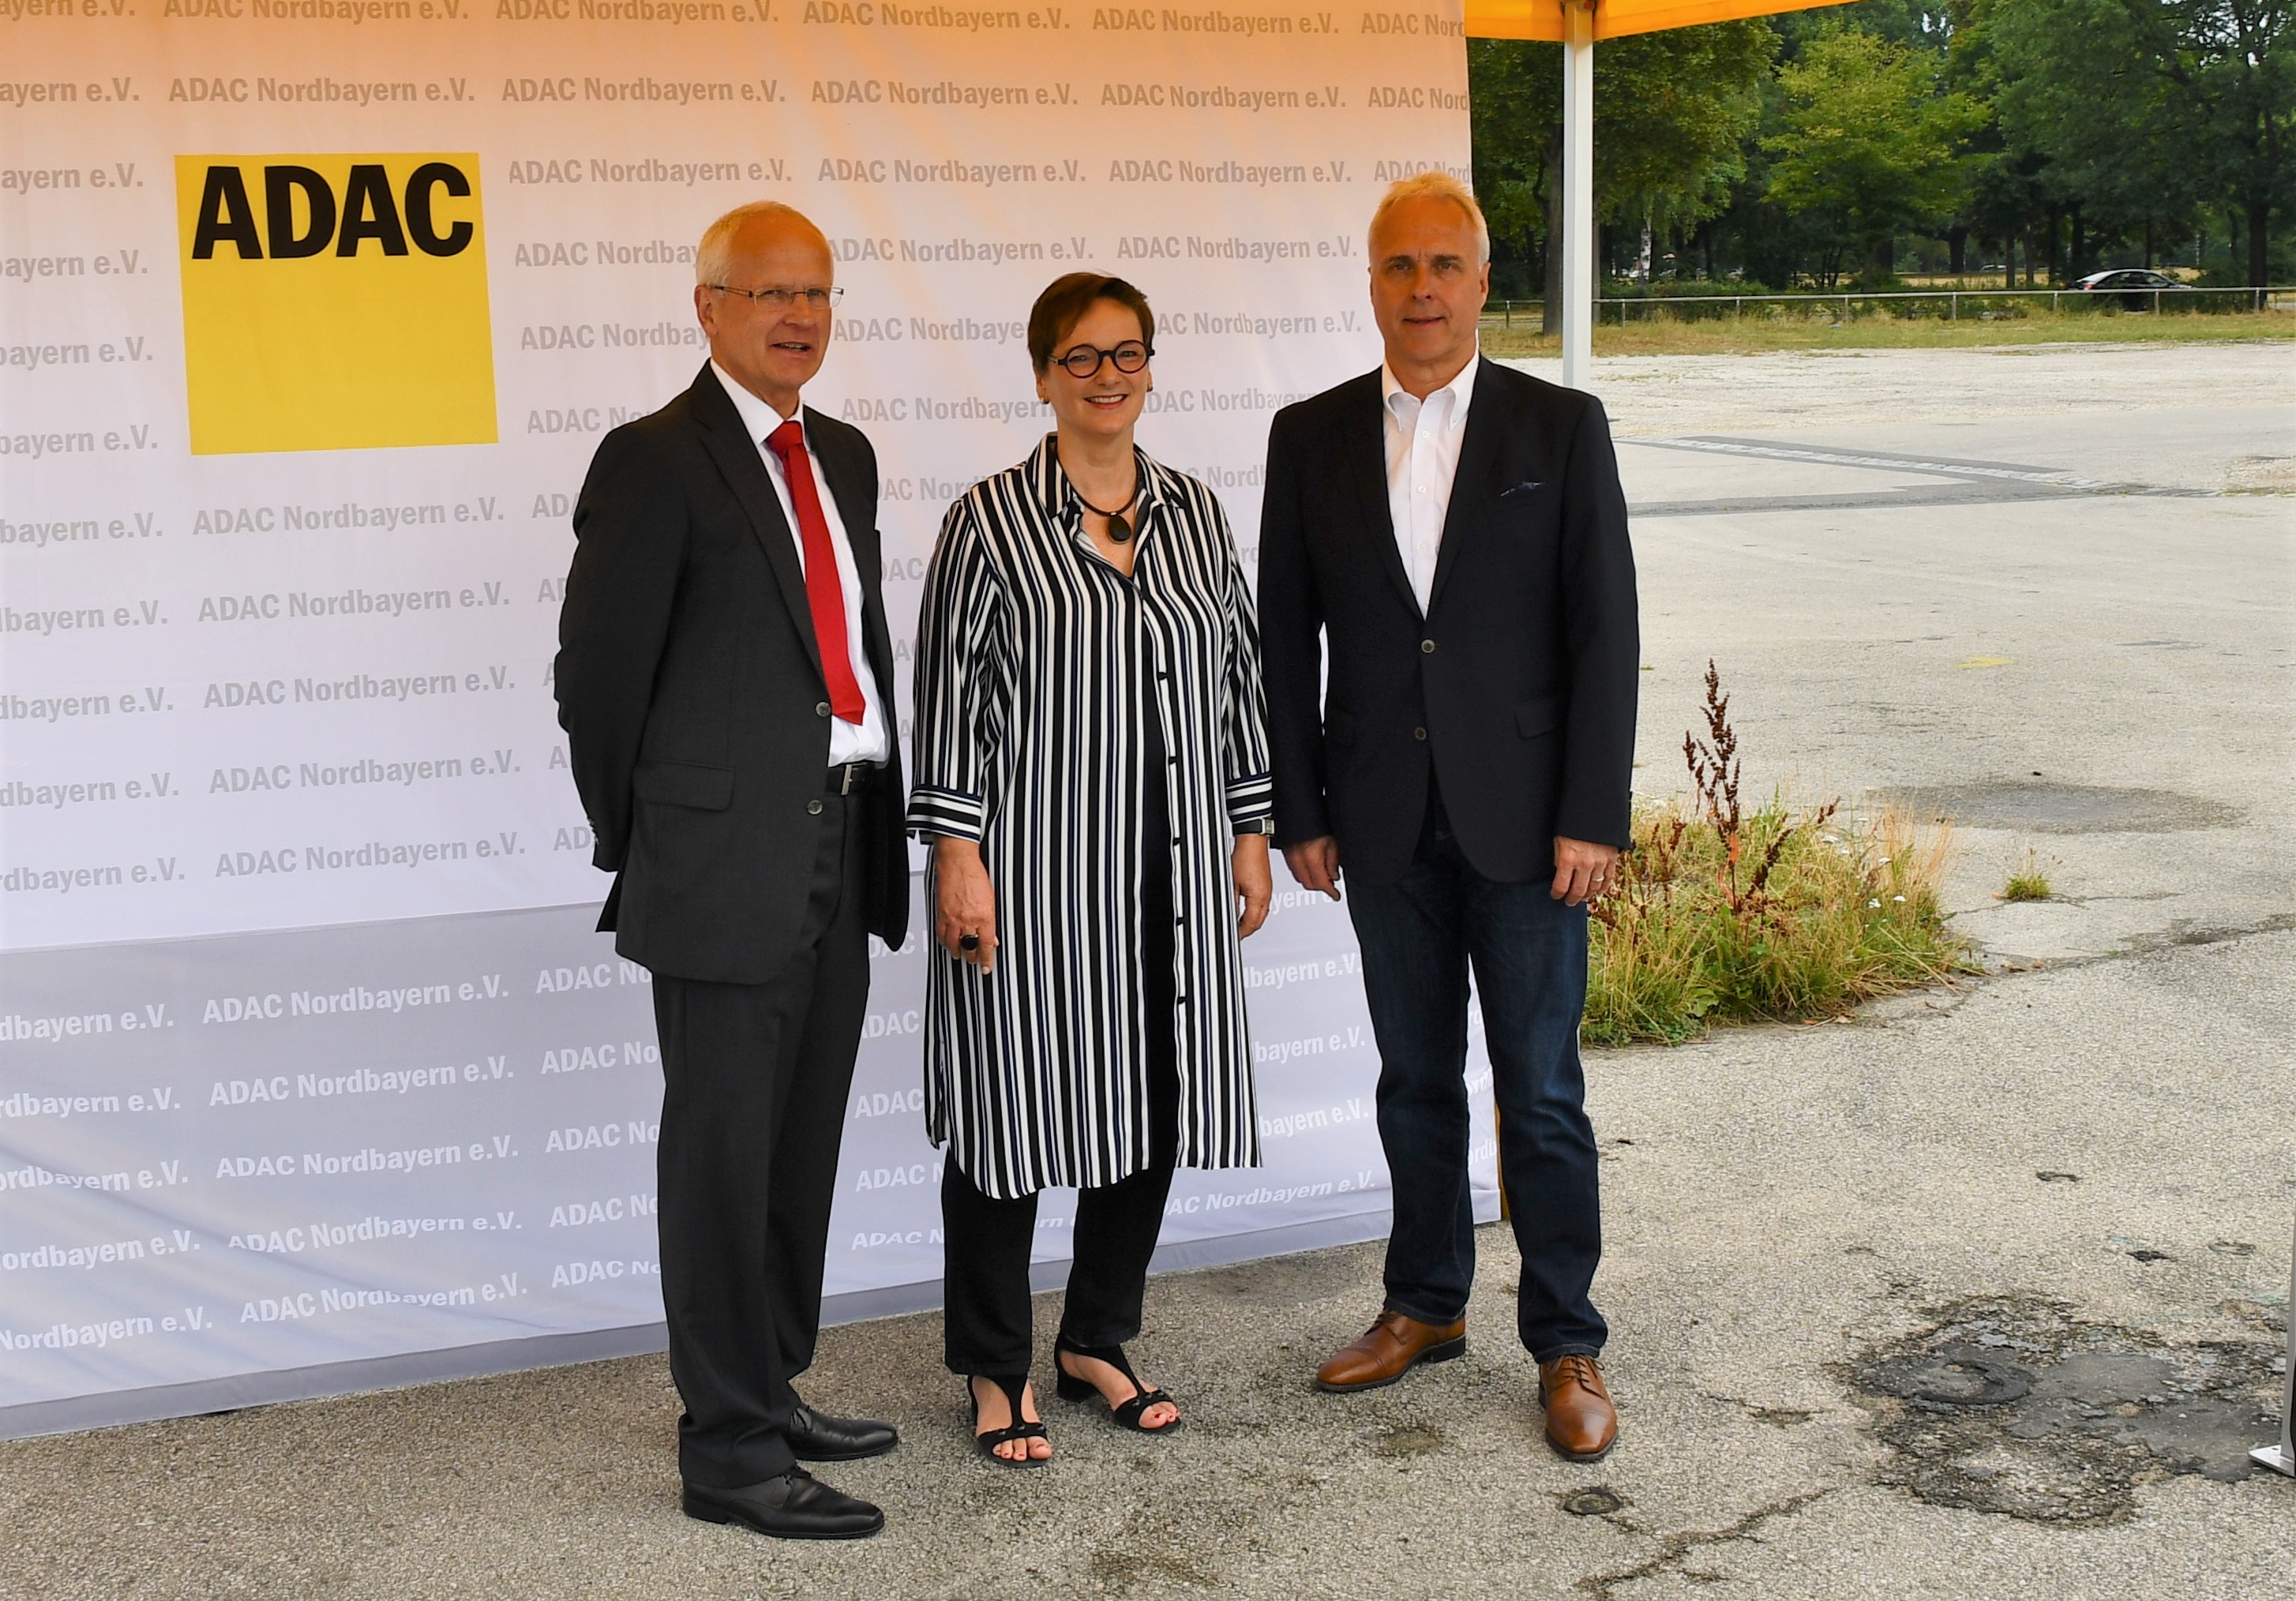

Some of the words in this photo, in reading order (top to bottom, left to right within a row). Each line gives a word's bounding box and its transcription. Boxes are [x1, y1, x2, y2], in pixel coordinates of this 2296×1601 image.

[163, 0, 242, 18] ADAC
[418, 0, 468, 20] e.V.
[496, 0, 570, 20] ADAC
[578, 0, 725, 25] Nordbayern
[731, 0, 778, 22] e.V.
[803, 0, 874, 26] ADAC
[881, 3, 1020, 32] Nordbayern
[1026, 7, 1070, 29] e.V.
[1093, 8, 1156, 31] ADAC
[1161, 9, 1292, 38] Nordbayern
[1299, 13, 1338, 34] e.V.
[1360, 13, 1419, 34] ADAC
[0, 83, 77, 108] ayern
[86, 77, 139, 102] e.V.
[169, 77, 248, 102] ADAC
[257, 77, 417, 107] Nordbayern
[425, 77, 475, 101] e.V.
[502, 77, 576, 102] ADAC
[584, 77, 733, 106] Nordbayern
[741, 80, 785, 102] e.V.
[812, 80, 881, 103] ADAC
[888, 81, 1029, 109] Nordbayern
[1036, 83, 1078, 105] e.V.
[1101, 84, 1165, 106] ADAC
[1170, 86, 1299, 113] Nordbayern
[1305, 86, 1345, 107] e.V.
[1368, 87, 1424, 108] ADAC
[2, 169, 81, 195] ayern
[89, 163, 143, 188] e.V.
[509, 159, 582, 184] ADAC
[591, 159, 740, 187] Nordbayern
[748, 158, 791, 182] e.V.
[818, 159, 886, 183] ADAC
[895, 159, 1037, 188] Nordbayern
[1043, 159, 1086, 182] e.V.
[1109, 159, 1172, 182] ADAC
[1179, 160, 1306, 187] Nordbayern
[1312, 161, 1351, 182] e.V.
[192, 162, 474, 259] ADAC
[516, 242, 588, 267] ADAC
[597, 240, 698, 267] Nordba
[899, 238, 1043, 265] Nordbayern
[1050, 237, 1093, 260] e.V.
[1117, 236, 1180, 258] ADAC
[1187, 236, 1310, 264] Nordbayern
[1317, 236, 1356, 257] e.V.
[0, 257, 84, 283] ayern
[94, 249, 148, 275] e.V.
[521, 324, 595, 351] ADAC
[834, 317, 902, 342] ADAC
[910, 317, 1029, 345] Nordbaye
[1194, 313, 1316, 339] Nordbayern
[1323, 311, 1360, 332] e.V.
[99, 336, 152, 362] e.V.
[527, 408, 600, 433] ADAC
[842, 398, 906, 421] ADAC
[103, 424, 157, 451] e.V.
[1207, 465, 1264, 488] Nord
[0, 519, 99, 548] bayern
[108, 512, 162, 538] e.V.
[193, 507, 275, 535] ADAC
[283, 503, 445, 531] Nordbayern
[454, 497, 504, 522] e.V.
[198, 594, 279, 622] ADAC
[288, 589, 451, 617] Nordbayern
[460, 581, 509, 607] e.V.
[0, 607, 104, 636] bayern
[114, 600, 167, 627] e.V.
[119, 687, 173, 713] e.V.
[204, 680, 285, 708] ADAC
[295, 674, 456, 703] Nordbayern
[465, 666, 515, 692] e.V.
[209, 765, 291, 793] ADAC
[300, 759, 462, 787] Nordbayern
[471, 749, 520, 775] e.V.
[125, 773, 178, 799] e.V.
[216, 849, 297, 877] ADAC
[306, 842, 467, 870] Nordbayern
[476, 832, 525, 857] e.V.
[131, 857, 185, 883] e.V.
[536, 964, 611, 993] ADAC
[203, 994, 283, 1023] ADAC
[291, 985, 450, 1016] Nordbayern
[458, 974, 508, 1001] e.V.
[121, 1003, 173, 1030] e.V.
[1329, 1025, 1366, 1051] e.V.
[541, 1044, 616, 1074] ADAC
[209, 1077, 289, 1106] ADAC
[297, 1066, 456, 1098] Nordbayern
[463, 1055, 513, 1082] e.V.
[128, 1087, 181, 1112] e.V.
[855, 1089, 923, 1118] ADAC
[1331, 1098, 1368, 1123] e.V.
[546, 1123, 621, 1153] ADAC
[216, 1156, 295, 1179] ADAC
[303, 1145, 461, 1175] Nordbayern
[469, 1134, 518, 1160] e.V.
[137, 1160, 188, 1188] e.V.
[855, 1164, 925, 1191] ADAC
[1206, 1182, 1332, 1210] Nordbayern
[1337, 1171, 1375, 1192] e.V.
[550, 1198, 623, 1228] ADAC
[150, 1230, 200, 1255] e.V.
[229, 1228, 306, 1253] ADAC
[310, 1217, 464, 1249] Nordbayern
[472, 1211, 522, 1230] e.V.
[852, 1231, 923, 1250] ADAC
[552, 1261, 624, 1288] ADAC
[241, 1293, 316, 1322] ADAC
[321, 1287, 475, 1314] Nordbayern
[481, 1273, 527, 1302] e.V.
[161, 1307, 212, 1331] e.V.
